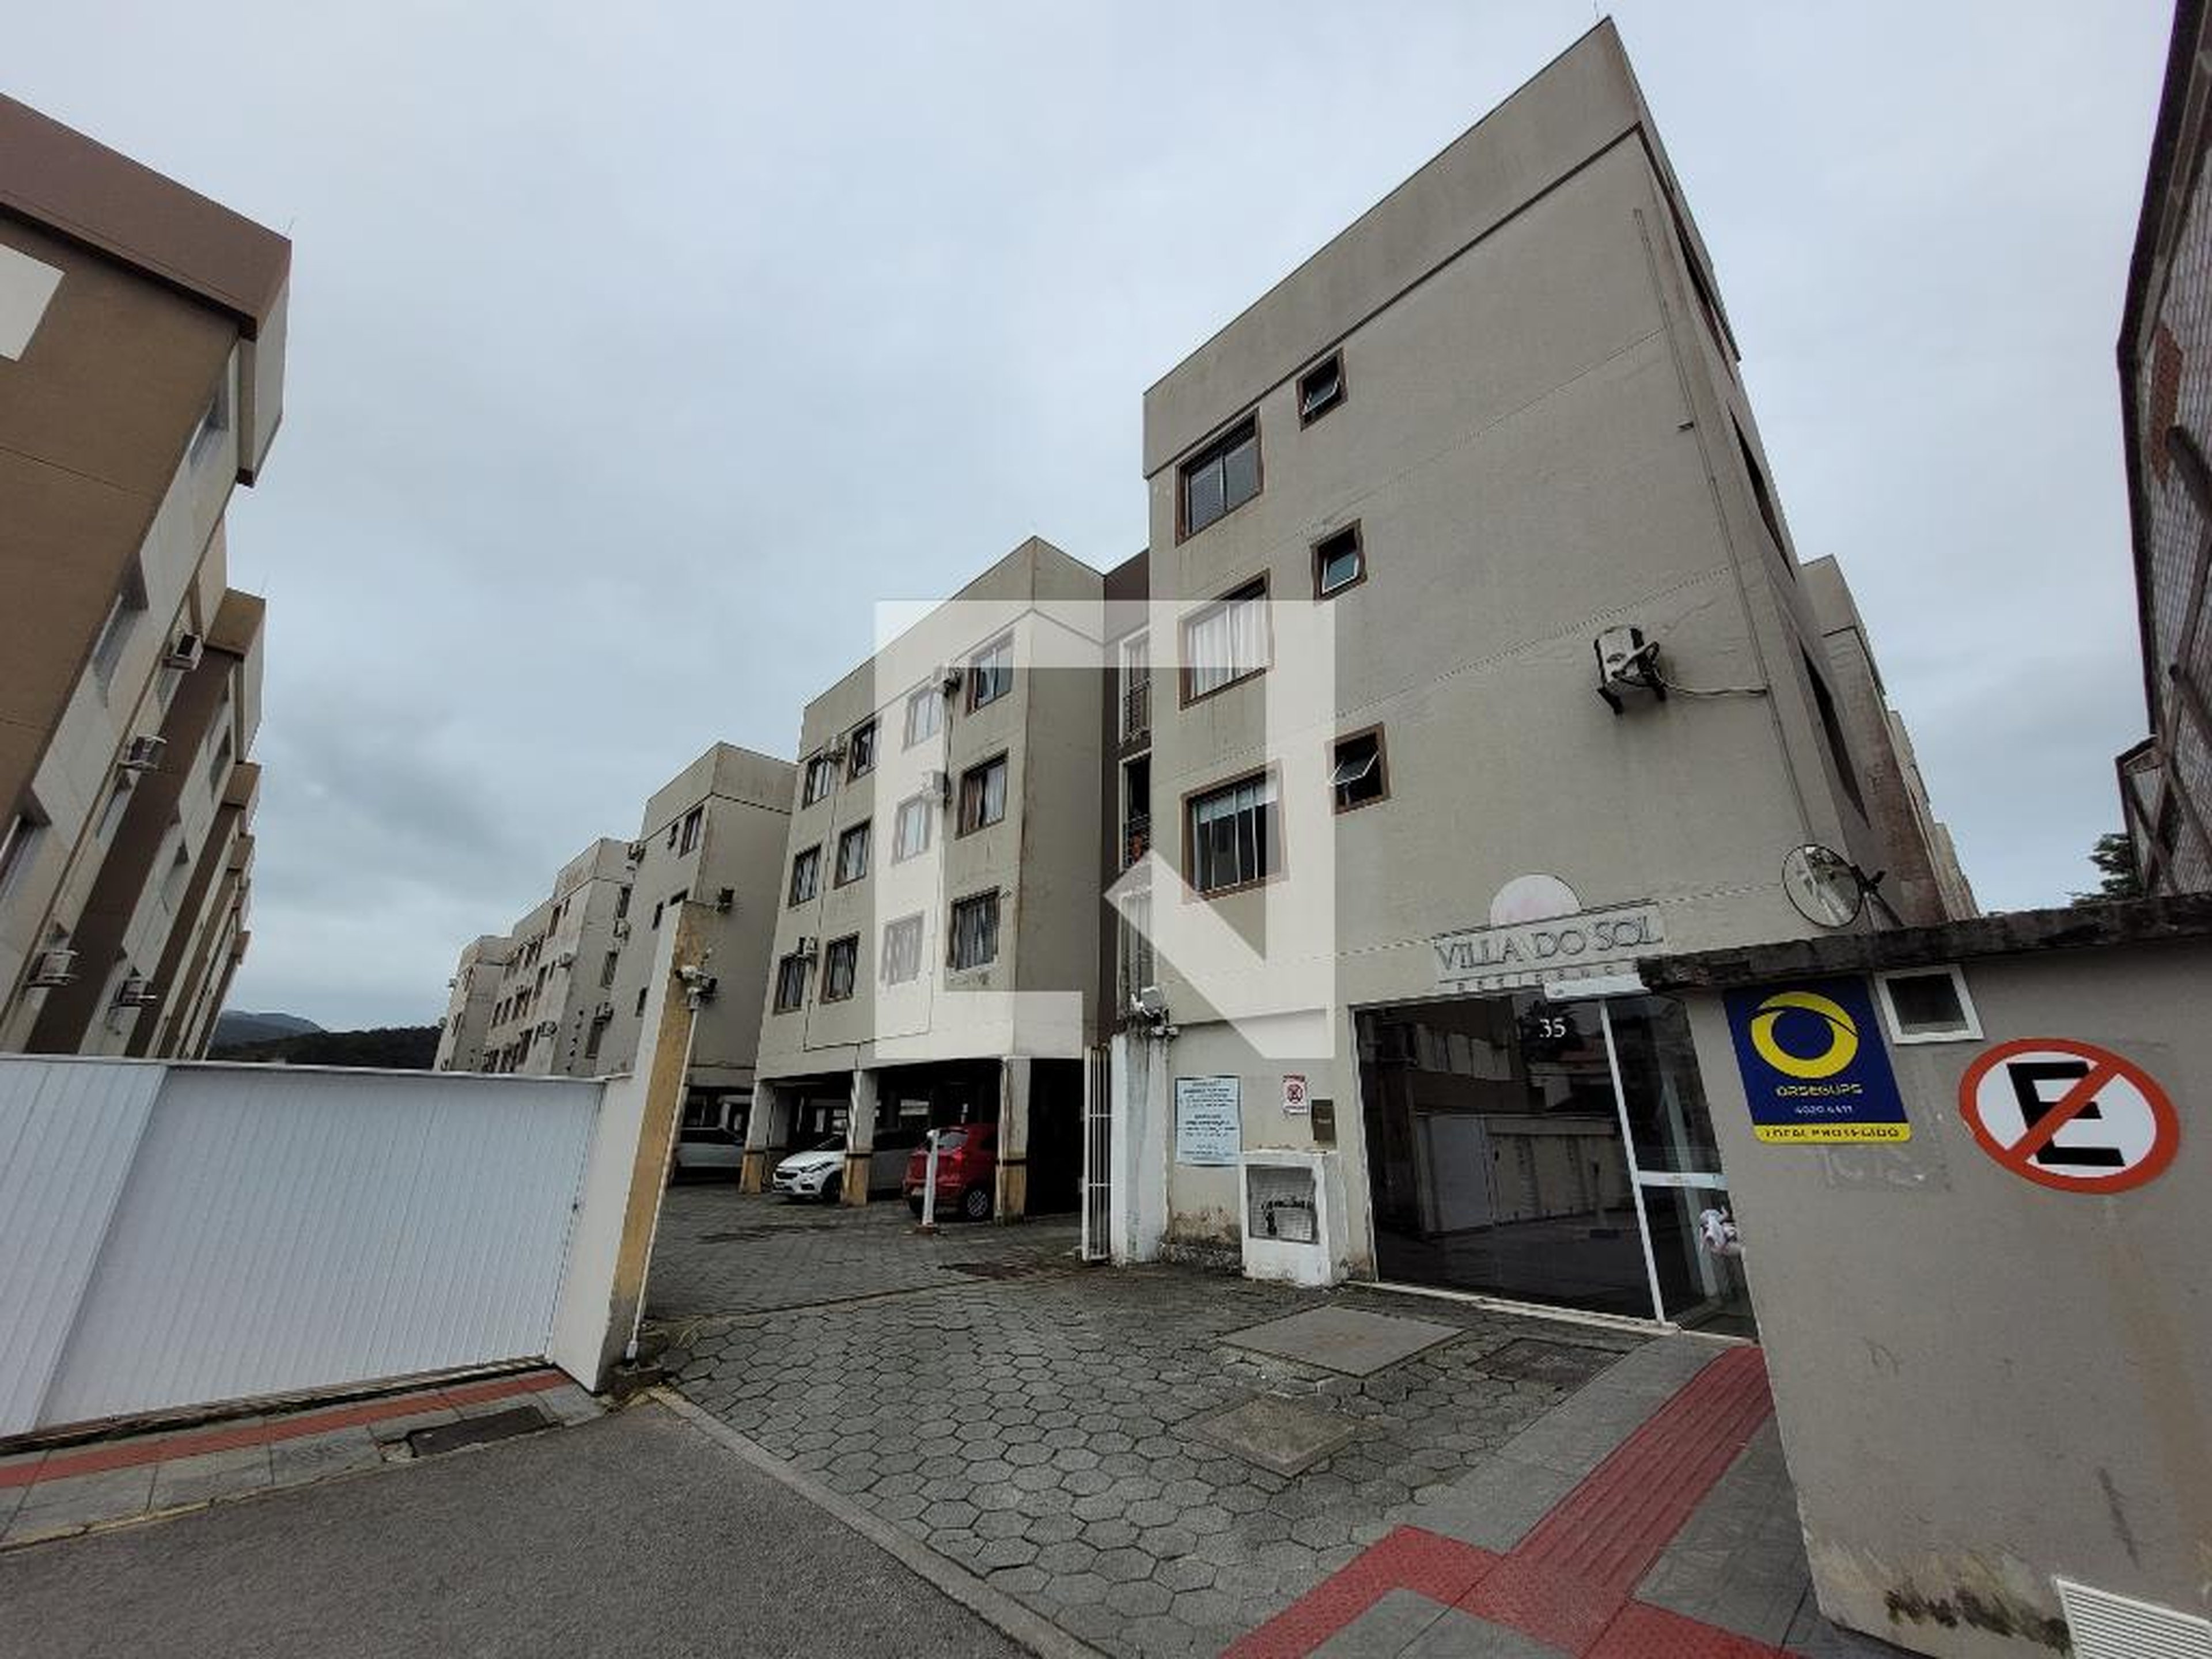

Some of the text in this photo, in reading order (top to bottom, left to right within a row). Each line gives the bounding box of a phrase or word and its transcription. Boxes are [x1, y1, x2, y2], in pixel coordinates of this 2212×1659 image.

[1433, 916, 1664, 970] VILLA DO SOL
[1539, 1017, 1566, 1037] 35
[1776, 1084, 1862, 1096] ORSEGUPS
[2006, 1061, 2126, 1167] E
